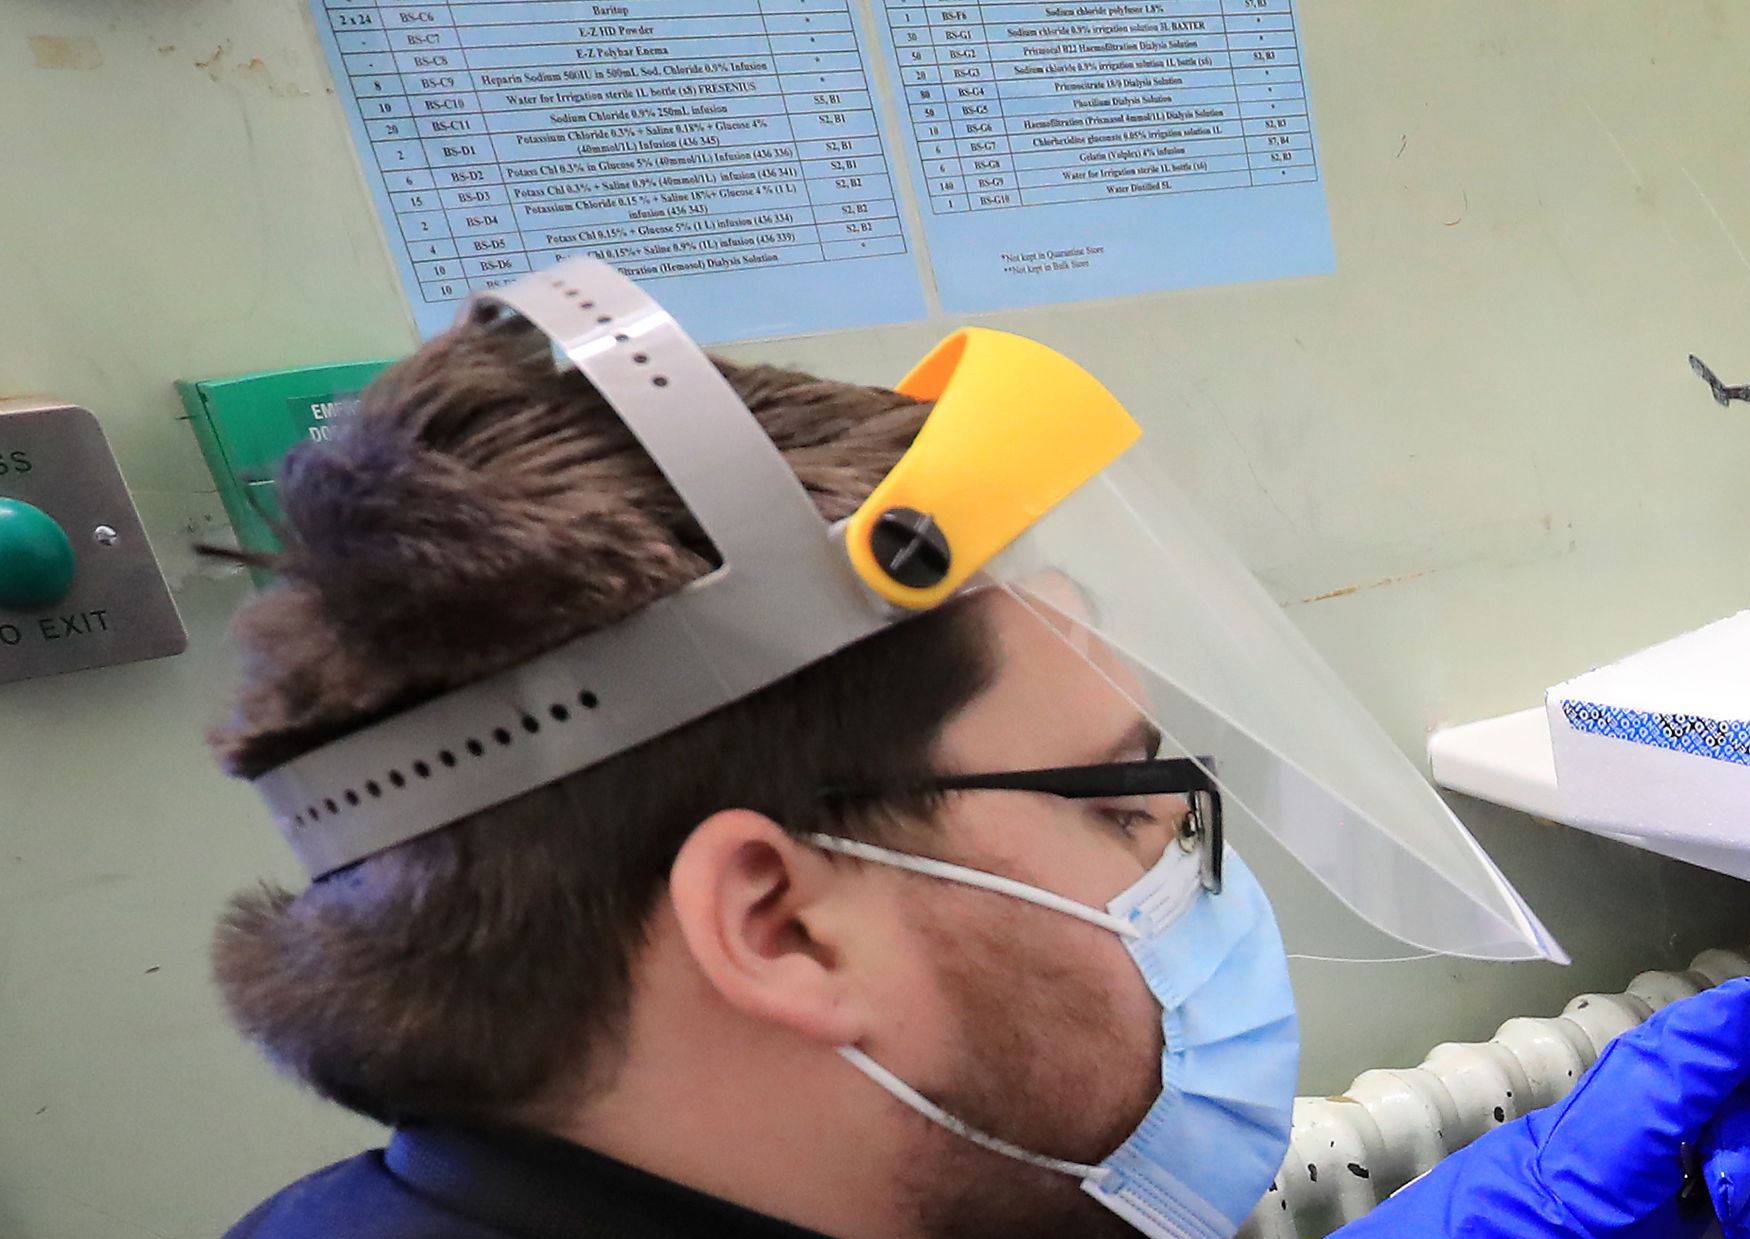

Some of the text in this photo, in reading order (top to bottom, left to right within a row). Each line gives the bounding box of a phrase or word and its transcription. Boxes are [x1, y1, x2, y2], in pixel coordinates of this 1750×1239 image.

[400, 12, 434, 22] BS-C6
[579, 25, 652, 37] E-Z HD Powder
[407, 34, 440, 45] BS-C7
[577, 45, 667, 59] E-Z Polybar Enema
[414, 56, 448, 66] BS-C8
[481, 72, 522, 86] Heparin
[524, 71, 561, 82] Sodium
[594, 69, 603, 79] in
[606, 67, 638, 78] 500mL
[640, 66, 660, 76] Sod.
[663, 64, 702, 75] Chloride
[704, 63, 727, 74] 0.9%
[731, 61, 766, 72] Infusion
[421, 79, 455, 88] BS-C9
[506, 93, 536, 104] Water
[539, 92, 553, 102] for
[556, 89, 602, 103] Irrigation
[604, 88, 632, 99] sterile
[636, 87, 647, 97] 1L
[650, 85, 675, 96] bottle
[698, 81, 755, 94] FRESENIUS
[379, 104, 391, 113] 10
[425, 100, 465, 110] BS-C10
[550, 104, 726, 122] Sodium Chloride 0.9% 250mL infusion
[386, 125, 398, 135] 20
[432, 121, 471, 132] BS-C11
[443, 147, 476, 157] BS-D1
[507, 148, 792, 177] Potass Chl 0.3% in Glucose 5% (40mmol/1L) Infusion (436 336)
[451, 171, 484, 182] BS-D2
[411, 198, 422, 206] 15
[458, 192, 491, 202] BS-D3
[466, 216, 498, 226] BS-D4
[474, 240, 505, 250] BS-D5
[480, 260, 512, 271] BS-D6
[434, 266, 446, 276] 10
[39, 610, 107, 641] EXIT
